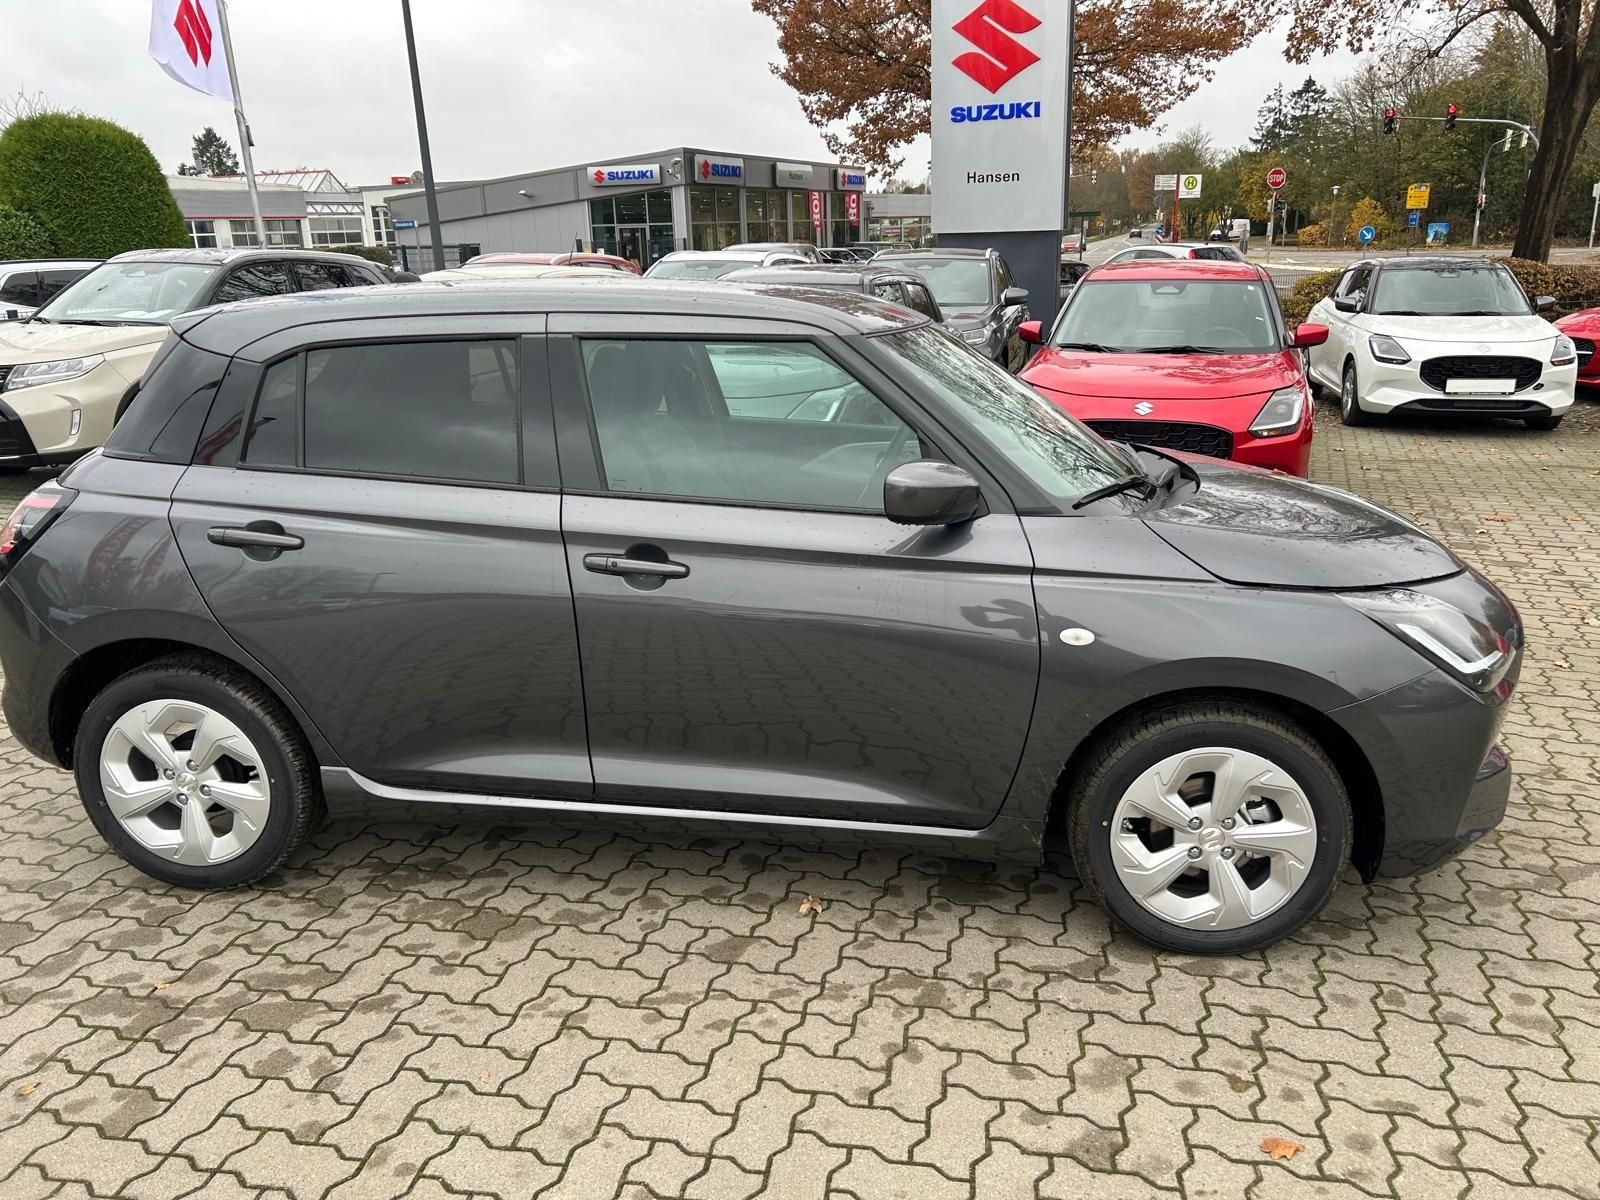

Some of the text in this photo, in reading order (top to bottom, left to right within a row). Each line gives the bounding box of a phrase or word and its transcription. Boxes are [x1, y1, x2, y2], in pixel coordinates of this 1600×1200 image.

[950, 101, 1041, 123] SUZUKI
[607, 169, 654, 181] SUZUKI
[711, 163, 742, 178] SUZUKI
[966, 171, 1021, 184] Hansen
[1269, 174, 1284, 183] STOP
